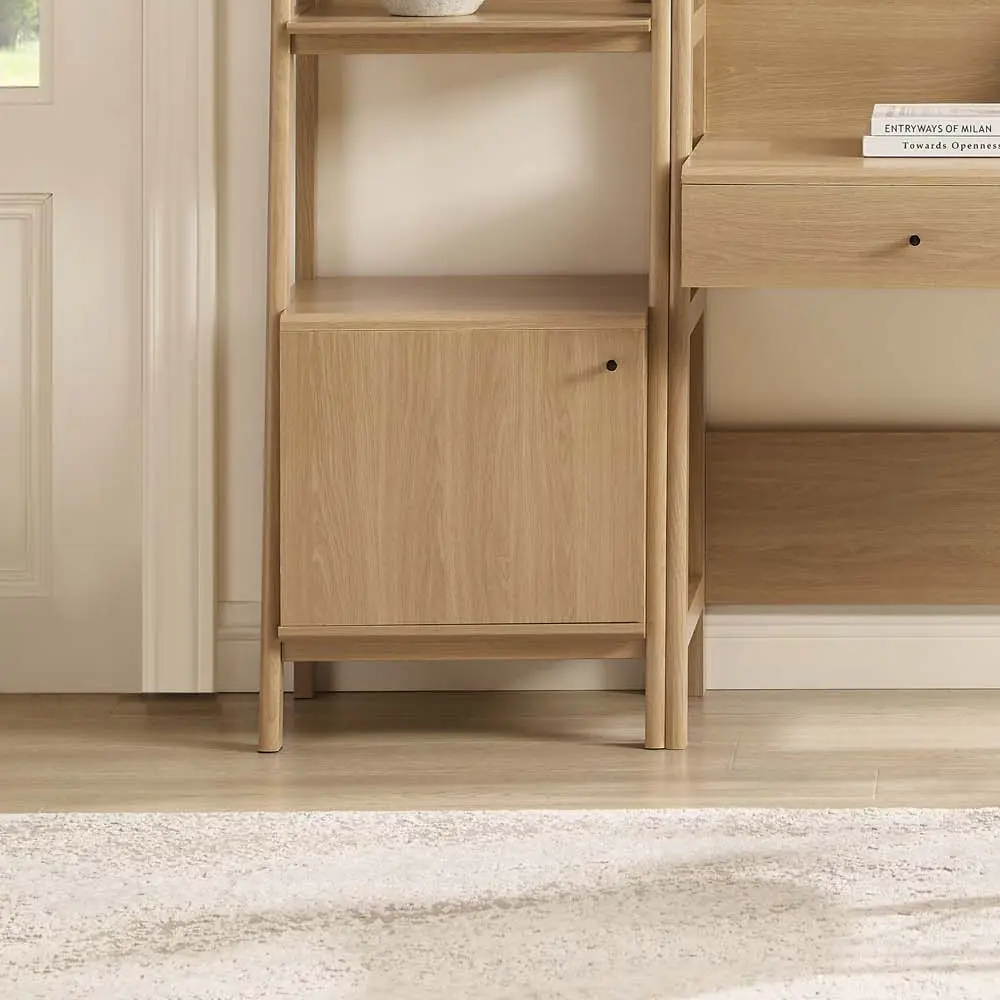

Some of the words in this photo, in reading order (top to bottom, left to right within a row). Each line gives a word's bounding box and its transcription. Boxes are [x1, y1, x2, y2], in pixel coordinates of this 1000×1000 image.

[884, 124, 943, 133] ENTRYWAYS
[945, 124, 959, 133] OF
[961, 124, 992, 133] MILAN
[901, 141, 947, 150] Towards
